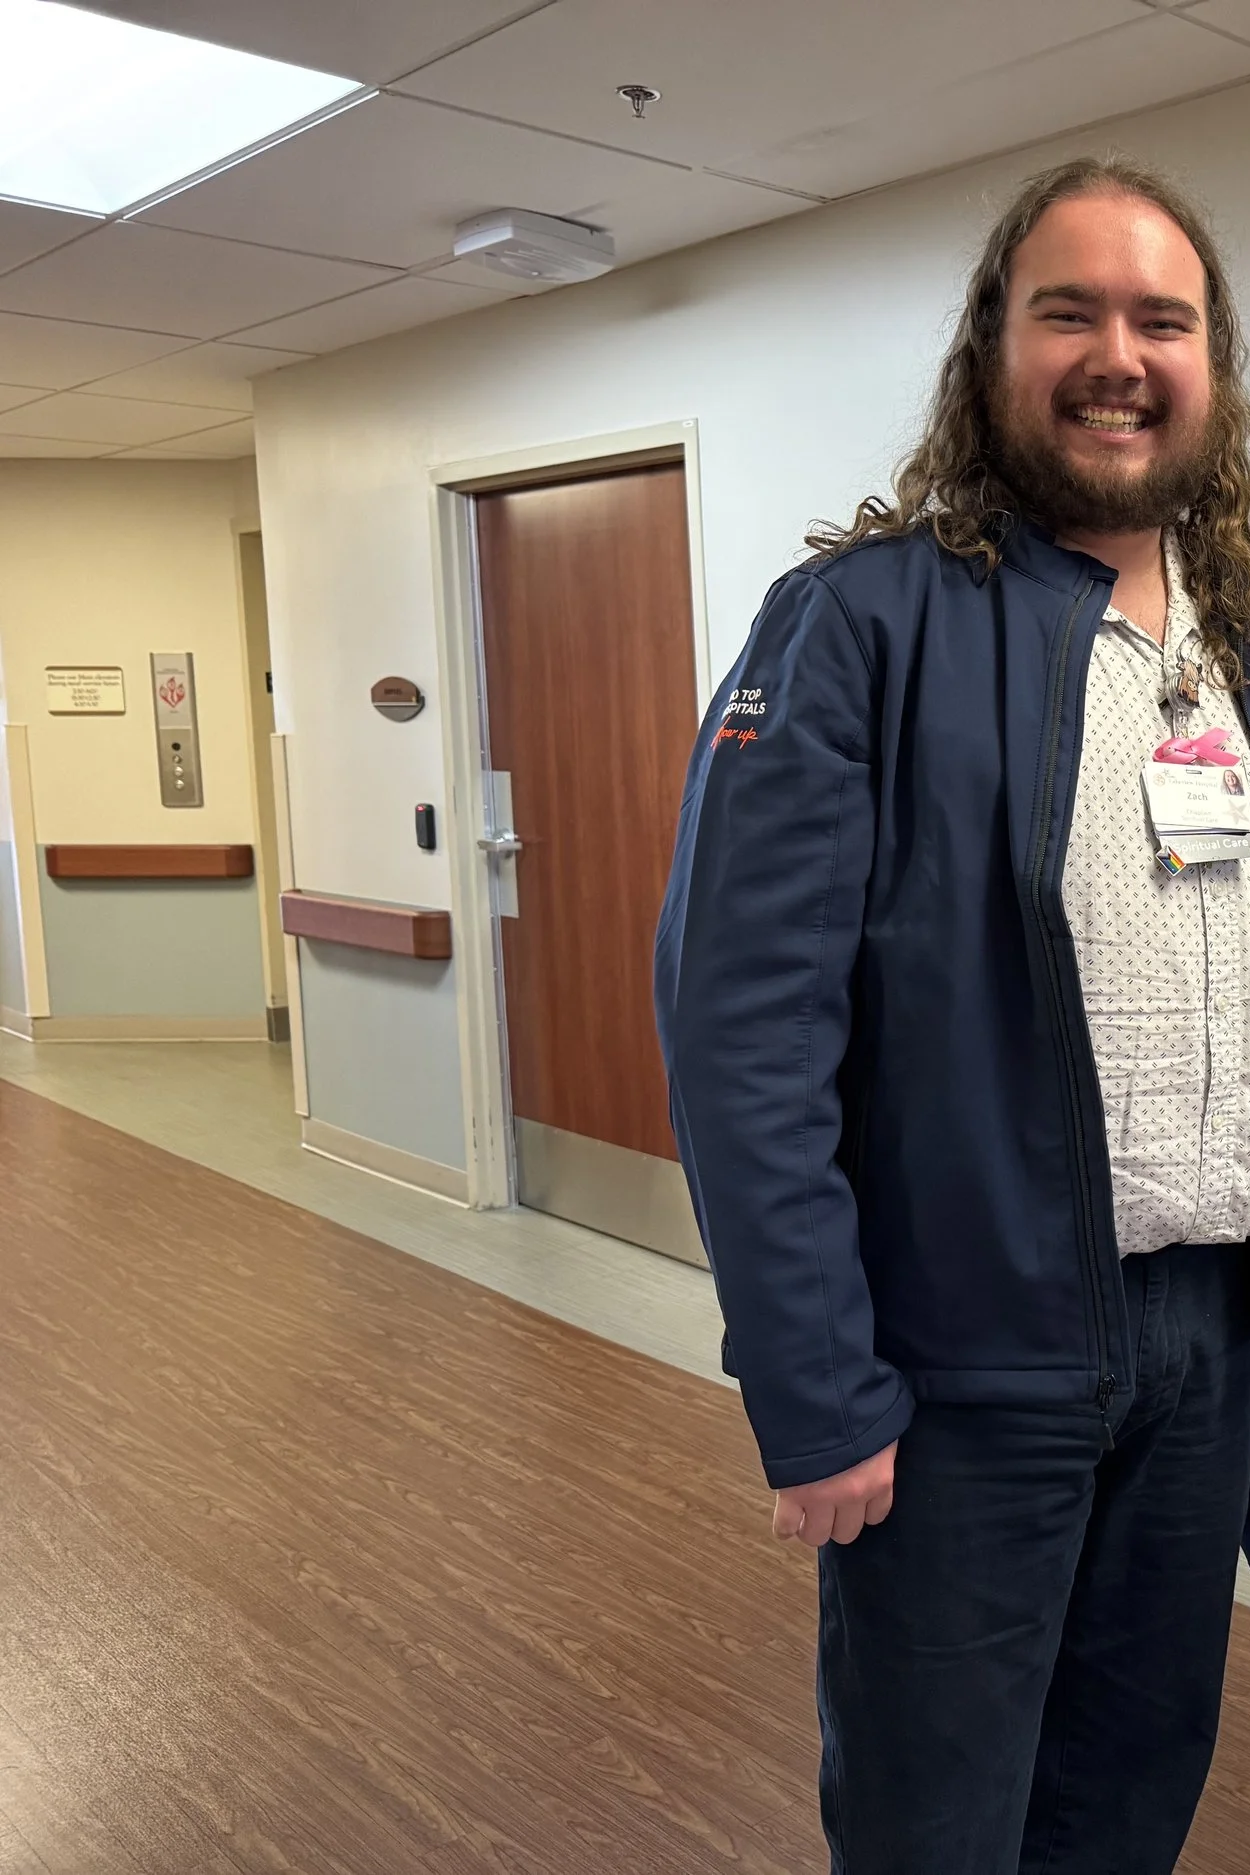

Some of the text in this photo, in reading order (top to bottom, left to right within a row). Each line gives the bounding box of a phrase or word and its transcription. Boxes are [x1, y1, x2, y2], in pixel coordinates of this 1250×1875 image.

[742, 688, 761, 701] TOP
[1187, 791, 1208, 801] Zach
[1175, 839, 1249, 853] Spiritual Care
